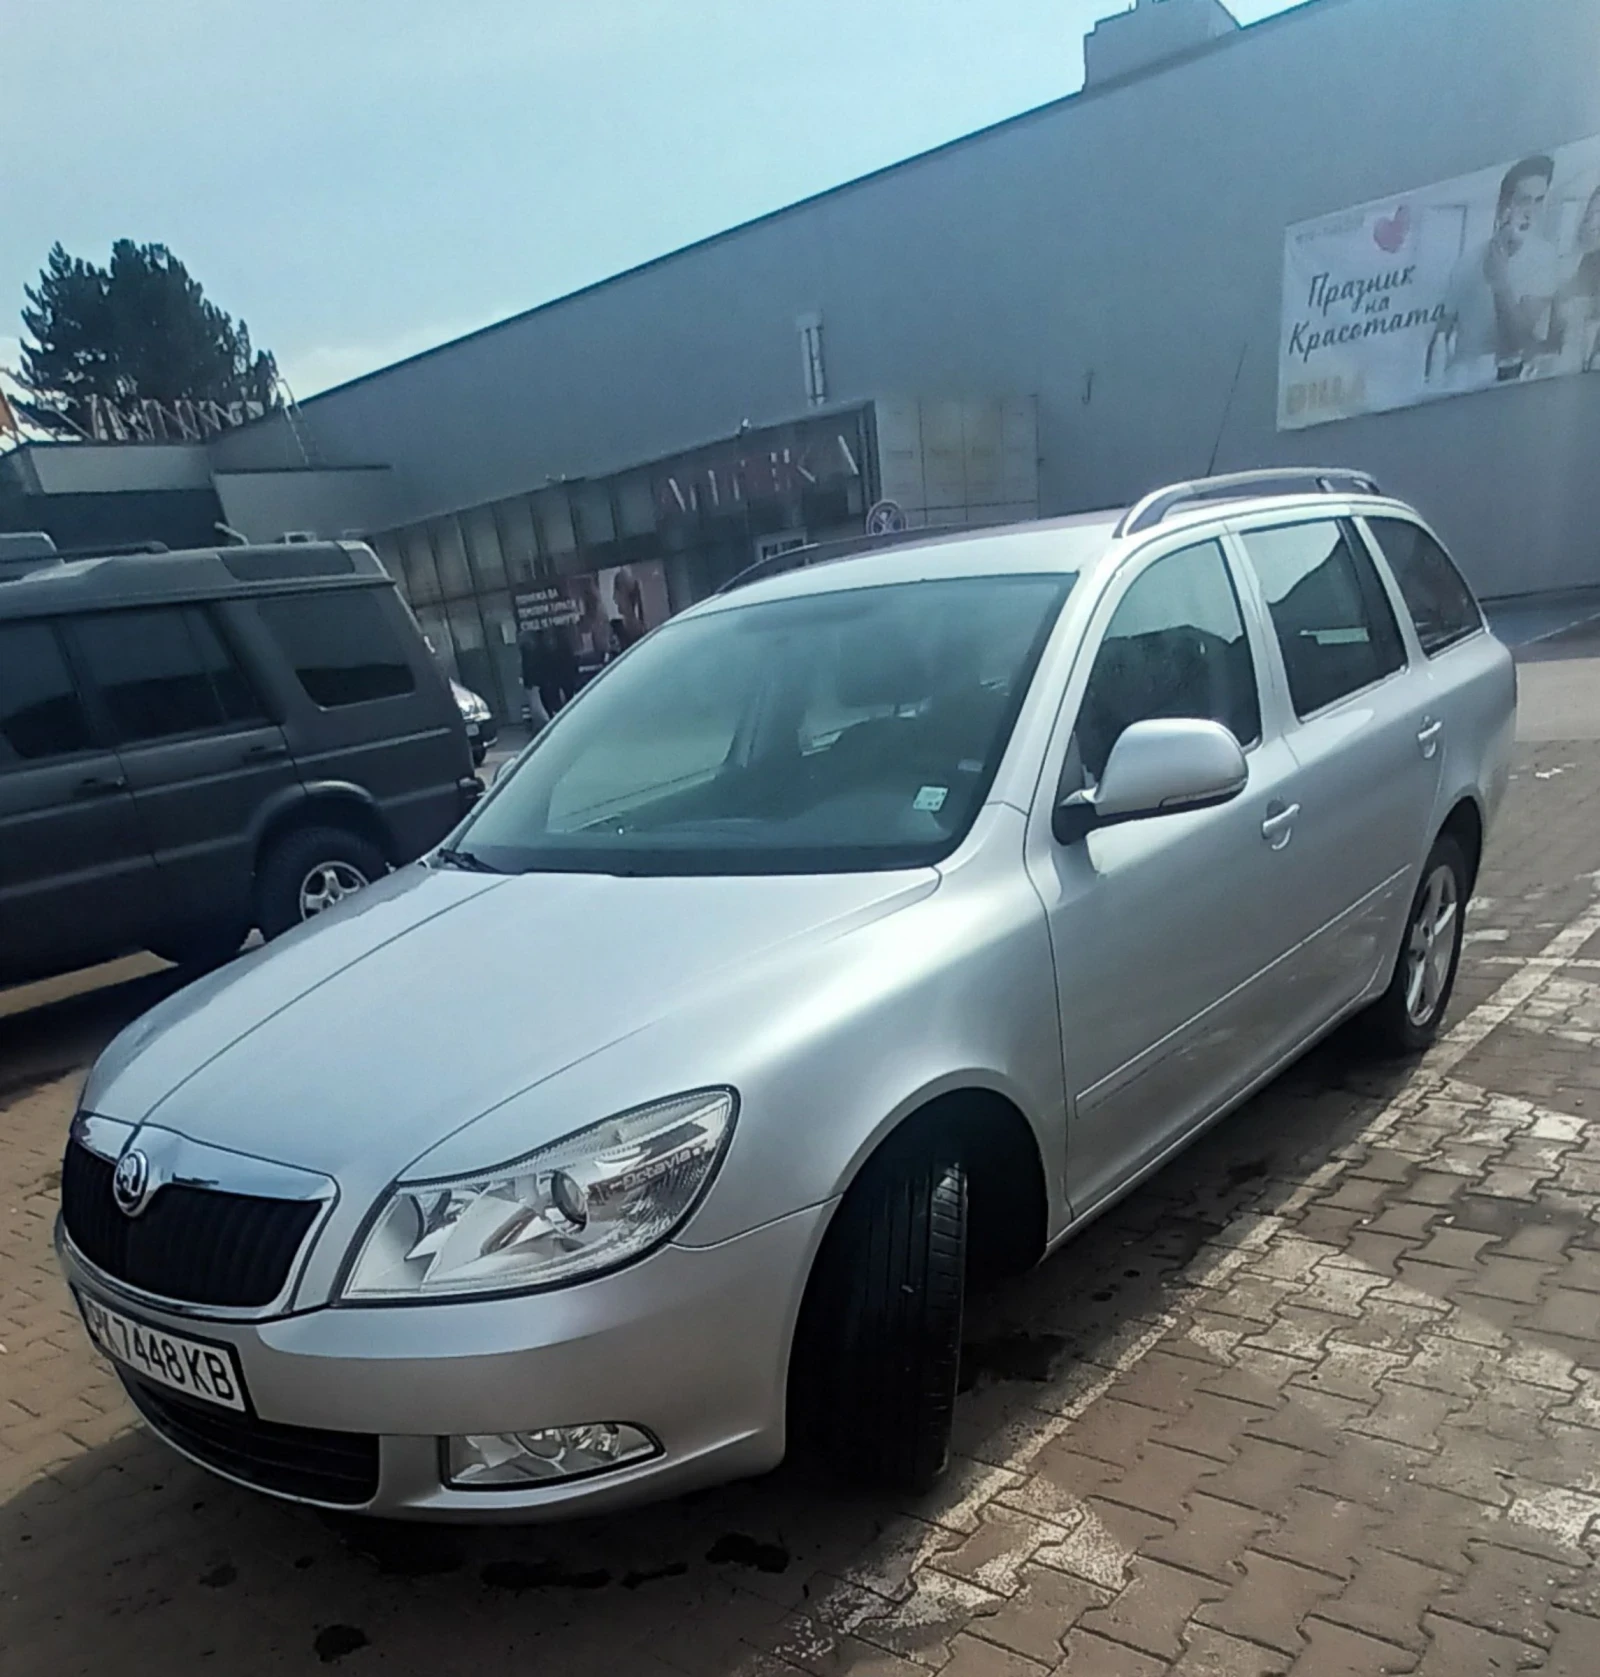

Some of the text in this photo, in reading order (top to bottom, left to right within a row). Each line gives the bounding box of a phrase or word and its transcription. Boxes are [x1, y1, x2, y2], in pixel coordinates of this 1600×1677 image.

[1308, 265, 1416, 316] Празник
[1365, 296, 1390, 315] на
[1289, 303, 1446, 362] Красотата
